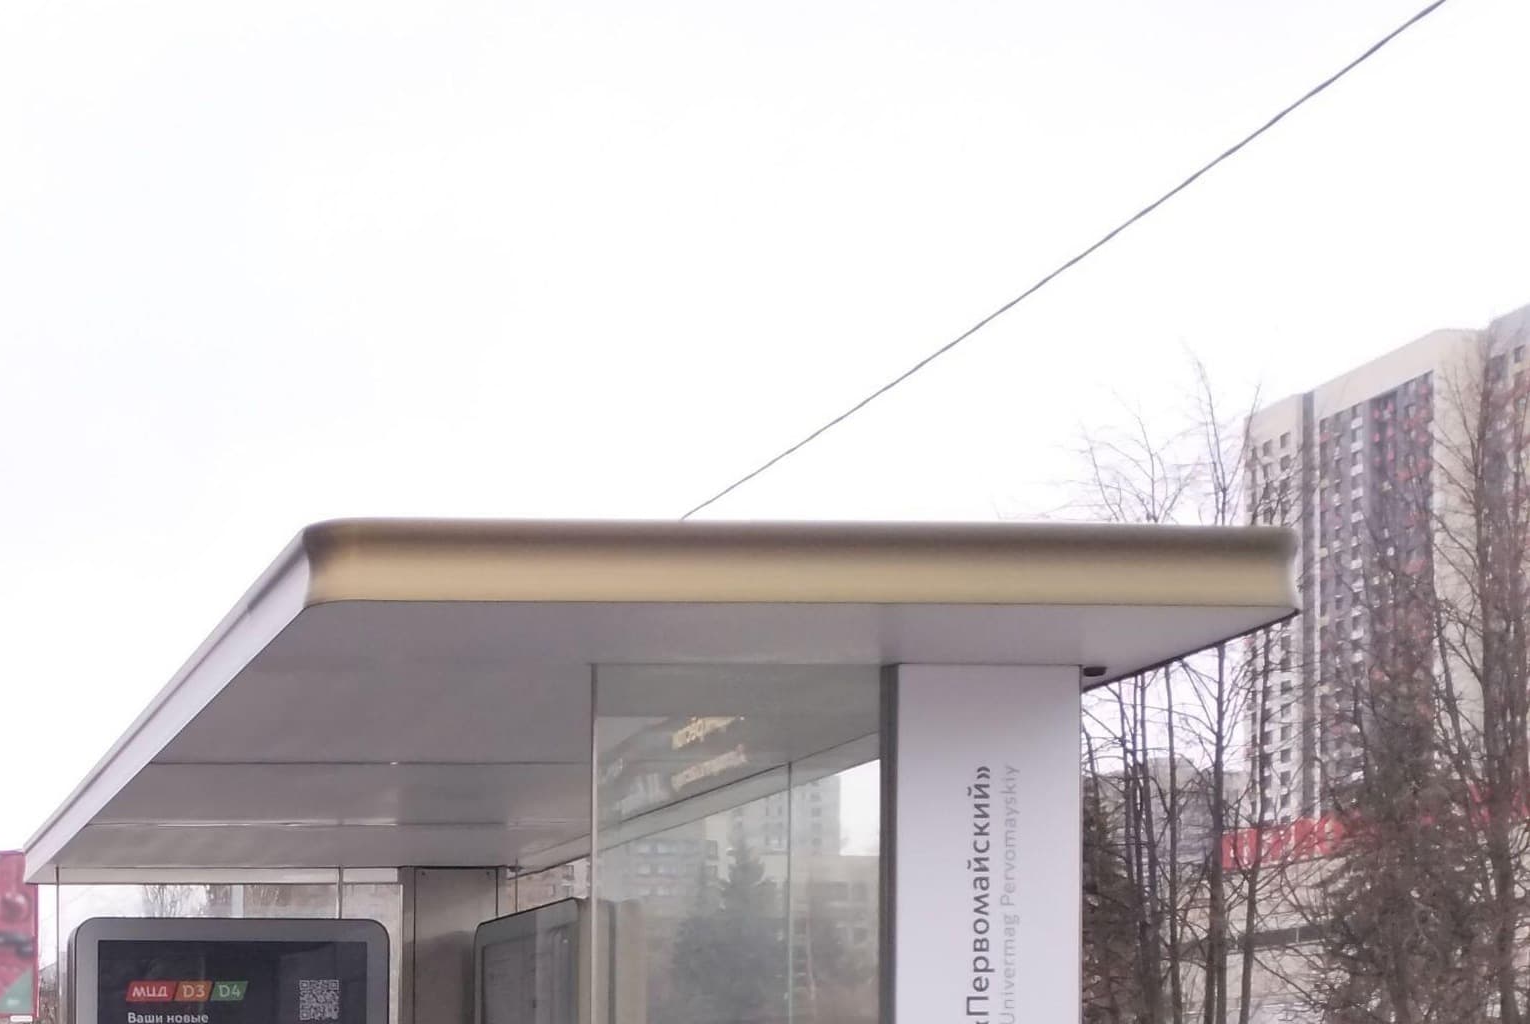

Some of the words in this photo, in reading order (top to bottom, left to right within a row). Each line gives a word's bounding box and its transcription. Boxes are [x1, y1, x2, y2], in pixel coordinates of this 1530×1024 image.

[999, 765, 1021, 906] Pervomayskiy
[132, 986, 168, 998] МЦД
[182, 984, 206, 998] D3
[218, 984, 241, 998] D4
[127, 1012, 163, 1024] Ваши
[166, 1014, 209, 1023] новые
